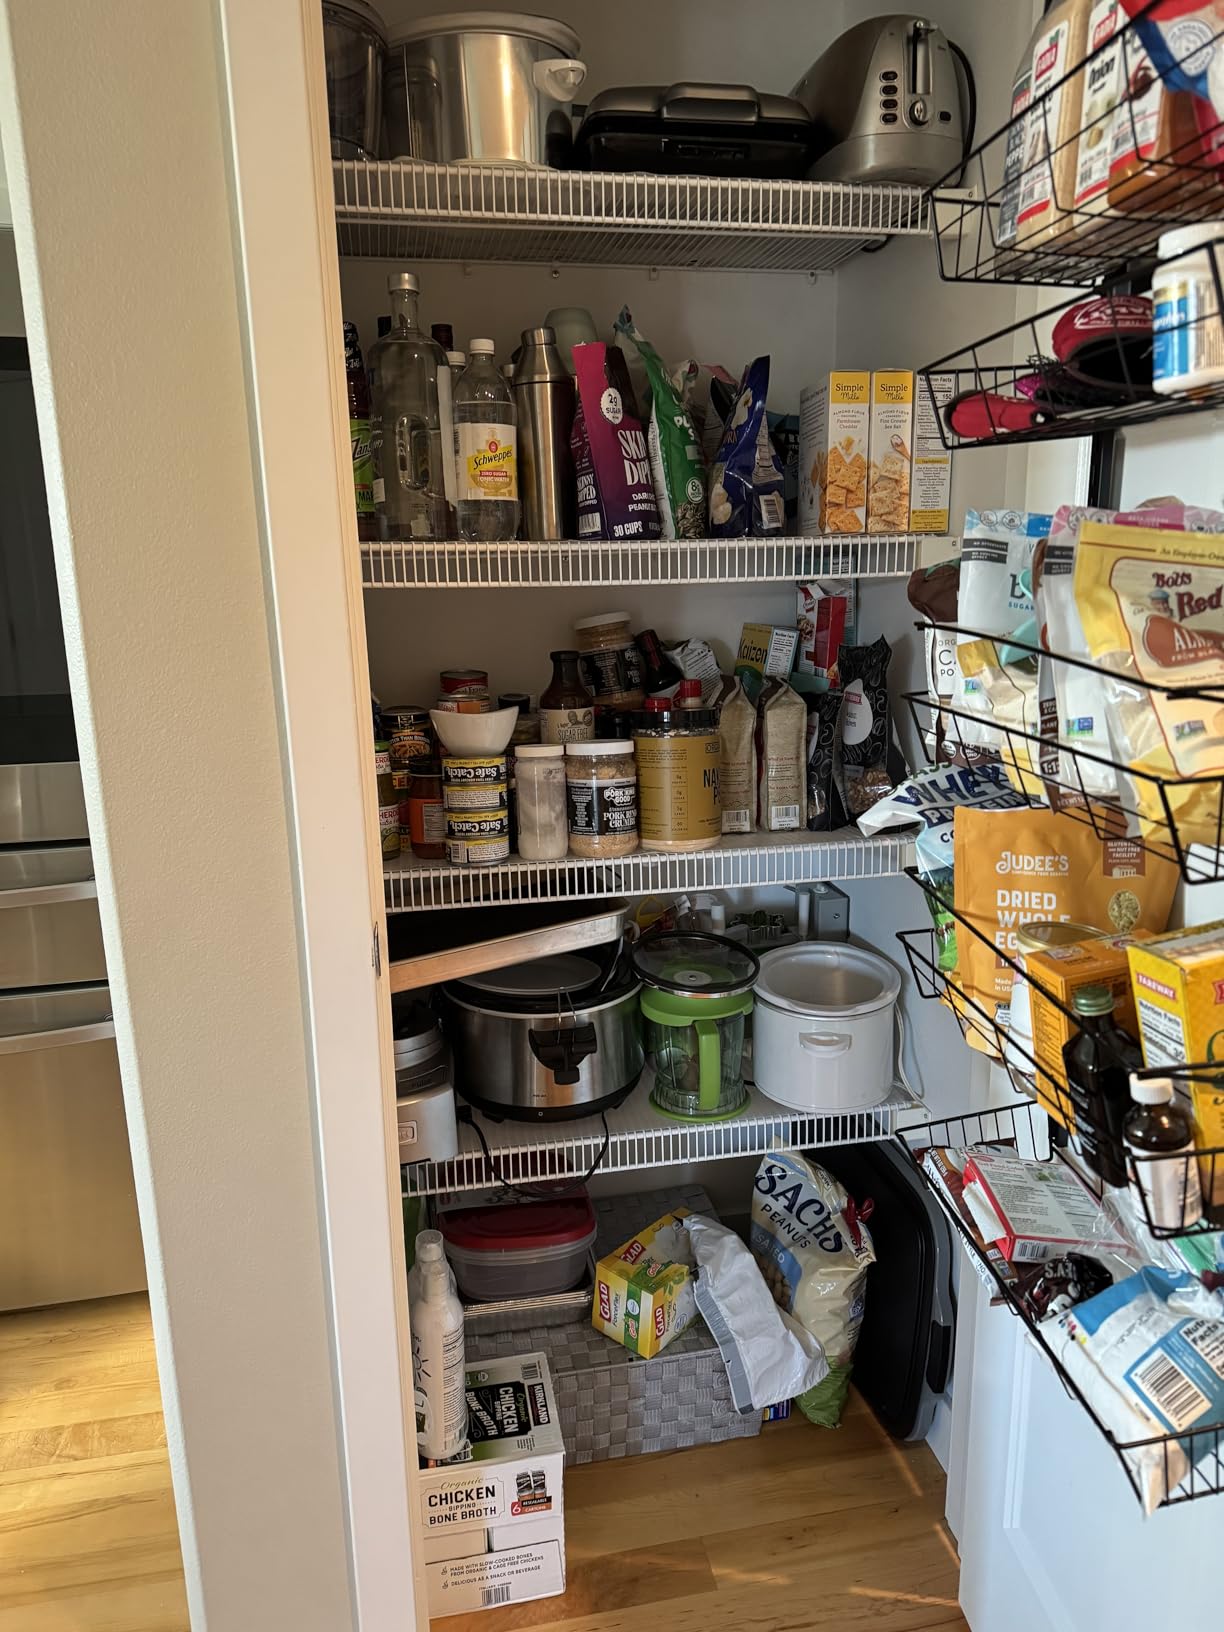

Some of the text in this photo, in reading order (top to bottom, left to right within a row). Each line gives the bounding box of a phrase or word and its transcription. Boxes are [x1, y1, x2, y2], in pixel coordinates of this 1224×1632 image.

[1088, 56, 1115, 90] Onion
[836, 384, 864, 392] Simple
[880, 384, 908, 393] Simple
[608, 393, 618, 407] 2g
[613, 521, 643, 537] 30 CUPS
[1176, 585, 1223, 622] Red
[738, 637, 768, 664] Kaizen
[446, 767, 497, 778] Safe Catch
[605, 790, 623, 799] PORK
[892, 765, 1000, 806] WHEY
[604, 812, 625, 820] PORK
[609, 818, 636, 828] CRUMBS
[450, 821, 501, 832] Safe Catch
[996, 851, 1070, 874] JUDEE'S
[997, 890, 1057, 910] DRIED
[995, 932, 1018, 950] EG
[995, 977, 1012, 986] Made
[1139, 1001, 1164, 1019] Nutrition
[754, 1164, 844, 1253] SACHS
[760, 1204, 811, 1249] PEANUTS
[621, 1243, 642, 1263] GLAD
[755, 1234, 785, 1264] SATED
[600, 1284, 610, 1319] GLAD
[656, 1308, 664, 1336] GLAD
[1191, 1324, 1219, 1346] Facts
[499, 1387, 519, 1433] CHICKEN
[534, 1384, 549, 1423] KIRKLAND
[465, 1392, 498, 1436] BONE BROTH
[440, 1477, 483, 1490] Organic
[428, 1485, 496, 1508] CHICKEN
[430, 1507, 497, 1525] BONE BROTH
[512, 1504, 521, 1514] 6
[480, 1556, 515, 1567] SLOW-COOKED
[520, 1556, 544, 1564] CHICKENS
[451, 1578, 477, 1586] DELICIOUS
[516, 1565, 540, 1574] BEVERAGE
